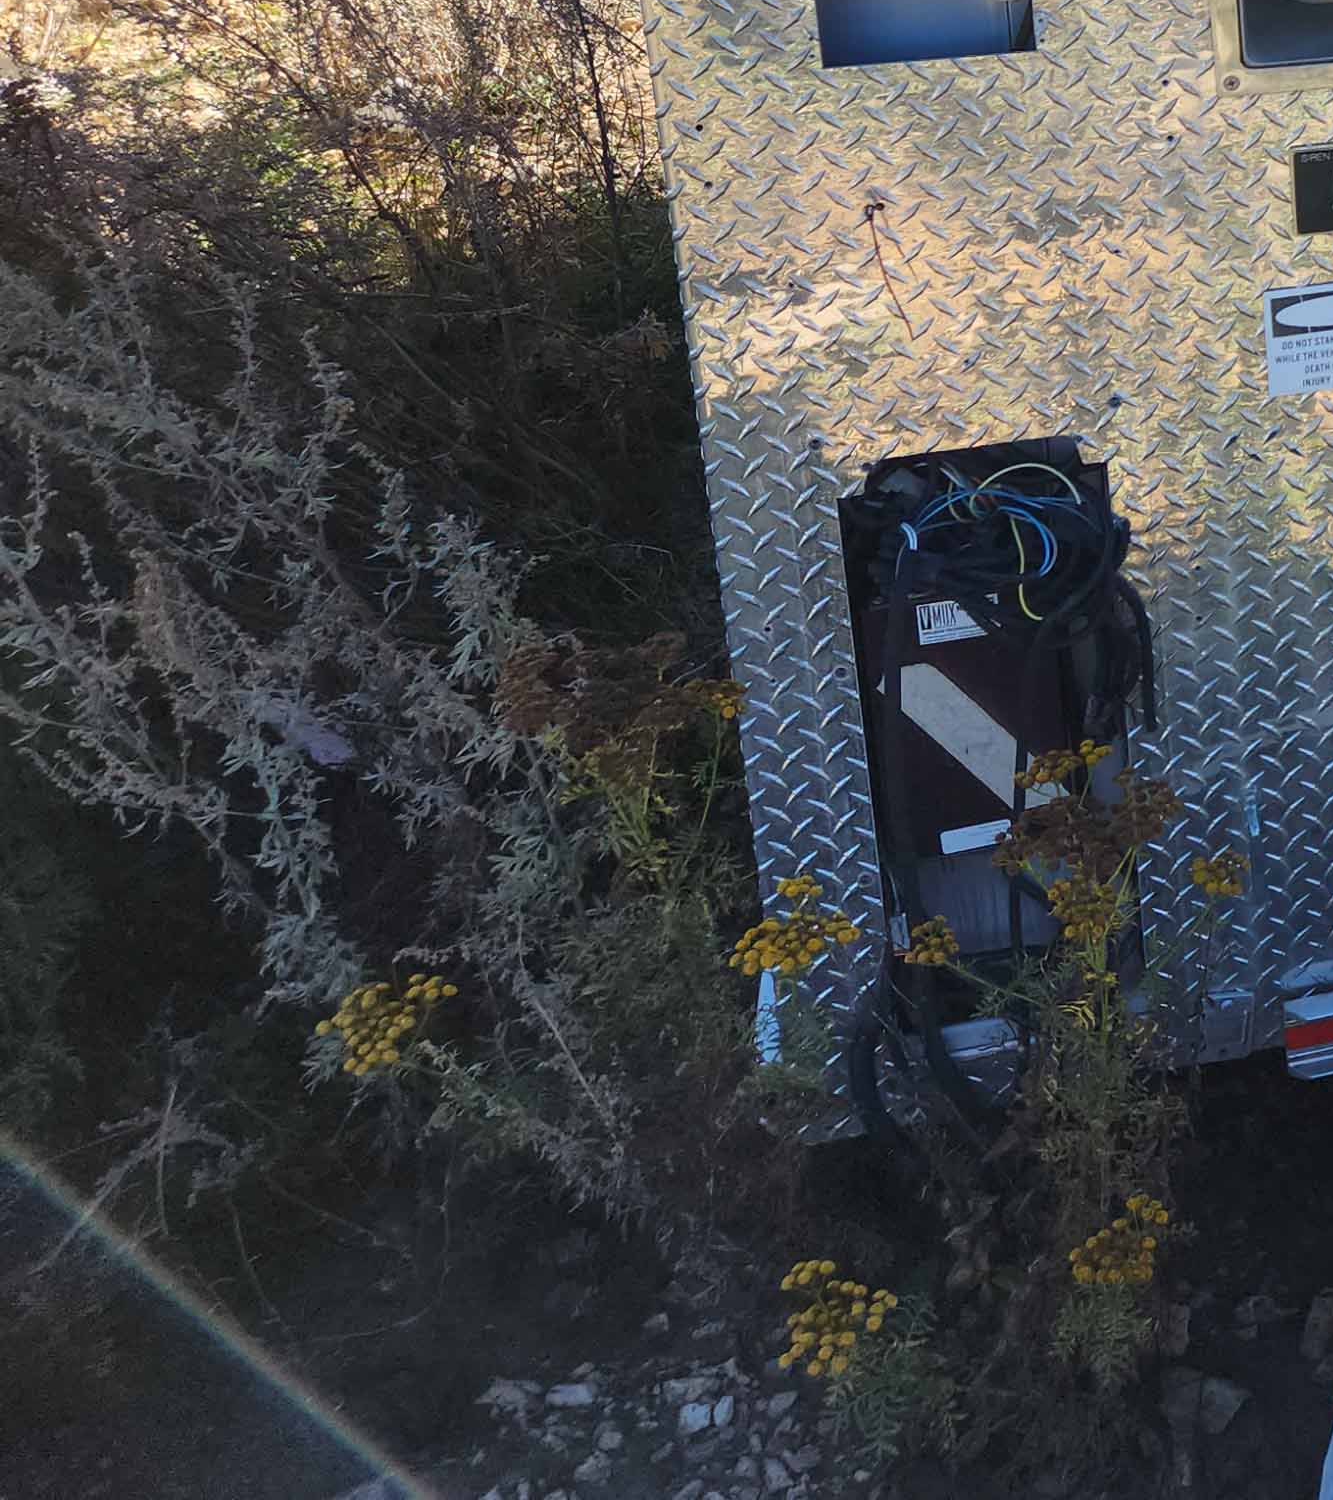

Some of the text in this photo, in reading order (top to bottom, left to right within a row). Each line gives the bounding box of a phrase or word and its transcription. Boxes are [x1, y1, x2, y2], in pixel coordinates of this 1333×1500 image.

[1300, 153, 1330, 163] SIREN
[1295, 338, 1312, 348] NOT
[1275, 353, 1300, 364] WHILE
[1302, 350, 1318, 361] THE
[1304, 362, 1330, 374] DEATH
[1302, 375, 1330, 388] INJURY
